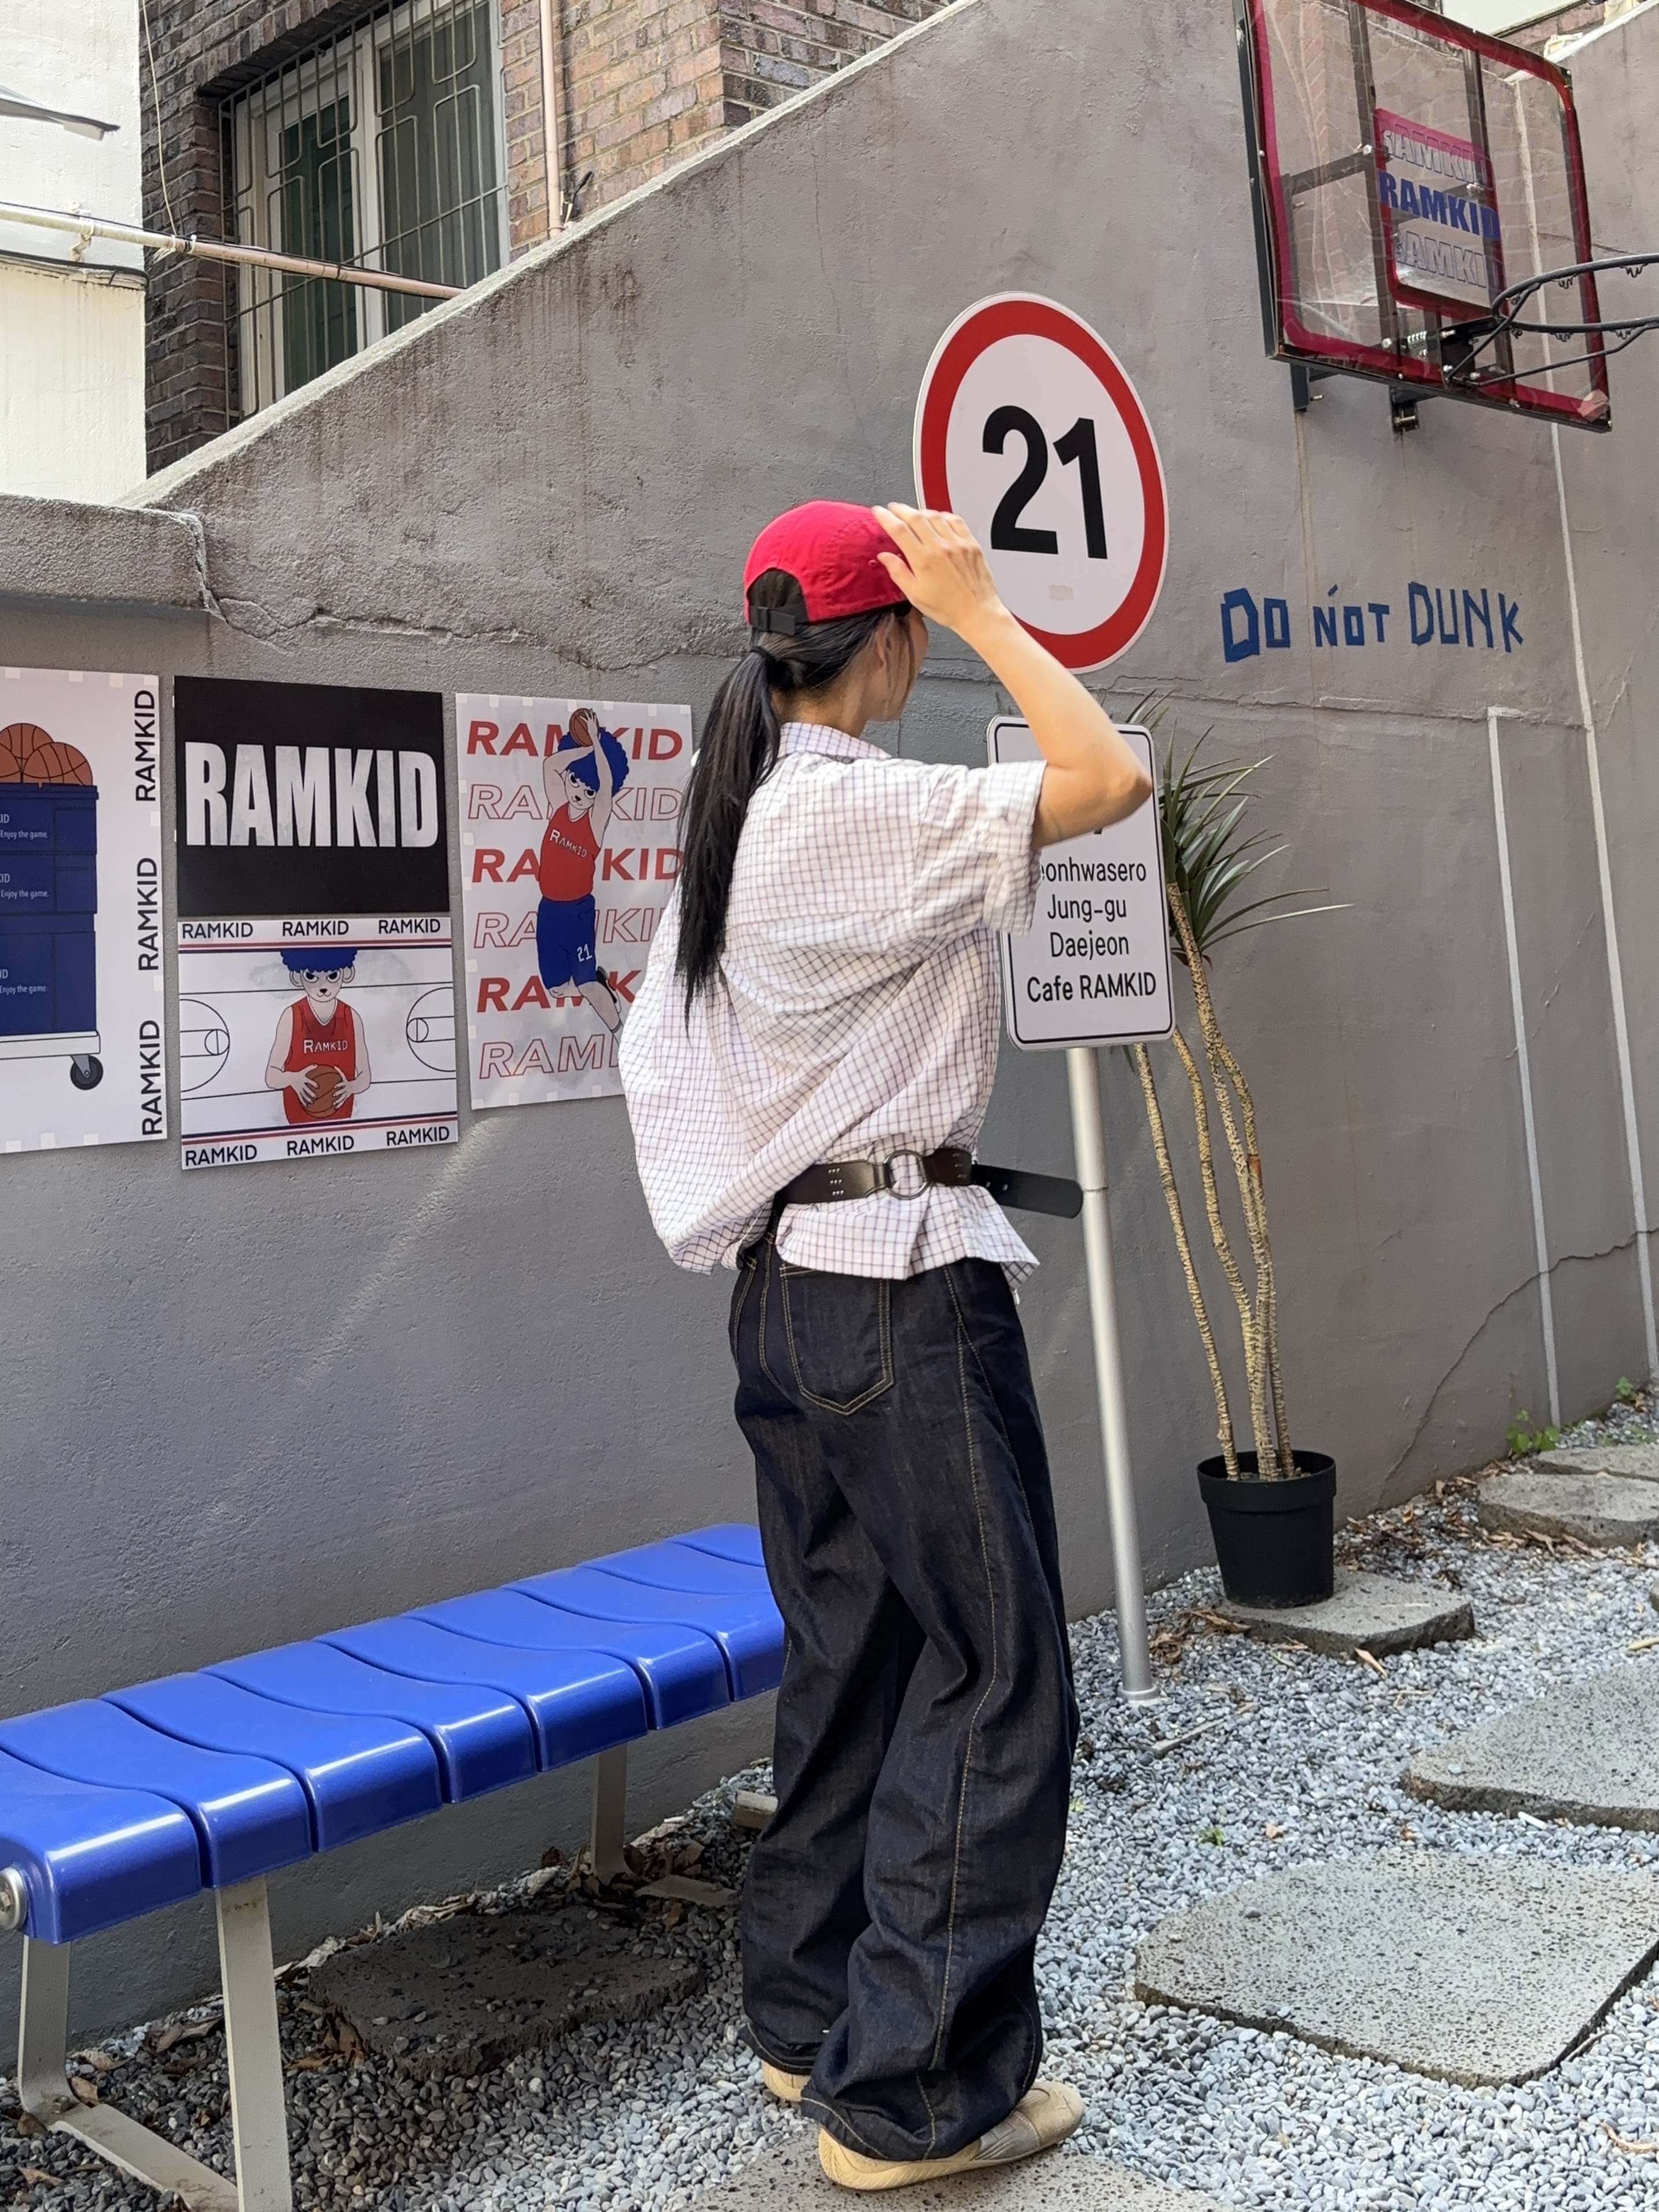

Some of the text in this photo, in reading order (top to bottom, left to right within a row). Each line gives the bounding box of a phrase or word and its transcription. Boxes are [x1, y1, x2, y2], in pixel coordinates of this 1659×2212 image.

[1378, 170, 1500, 241] RAMKID
[982, 405, 1108, 560] 21
[1408, 581, 1523, 653] DUNK
[134, 690, 156, 801] RAMKID
[185, 741, 439, 848] RAMKID
[468, 784, 685, 820] RAKID
[1, 829, 17, 840] Enjoy
[19, 830, 29, 838] the
[550, 829, 587, 857] RAMKID
[472, 848, 685, 882] RAKID
[1, 889, 18, 900] Enjoy
[19, 889, 29, 897] the
[1047, 894, 1127, 923] Jung-gu
[137, 857, 159, 970] RAMKID
[182, 918, 440, 938] RAMKID RAMKID RAMKID
[474, 908, 665, 948] RAKI
[577, 944, 593, 962] 21
[1050, 930, 1129, 960] Daejeon
[0, 985, 16, 995] Enjoy
[17, 985, 28, 993] the
[1027, 971, 1156, 1002] Cafe RAMKID
[304, 1039, 348, 1054] RAMKID
[139, 1020, 163, 1135] RAMKID
[185, 1126, 450, 1166] RAMKID RAMKID RAMKID
